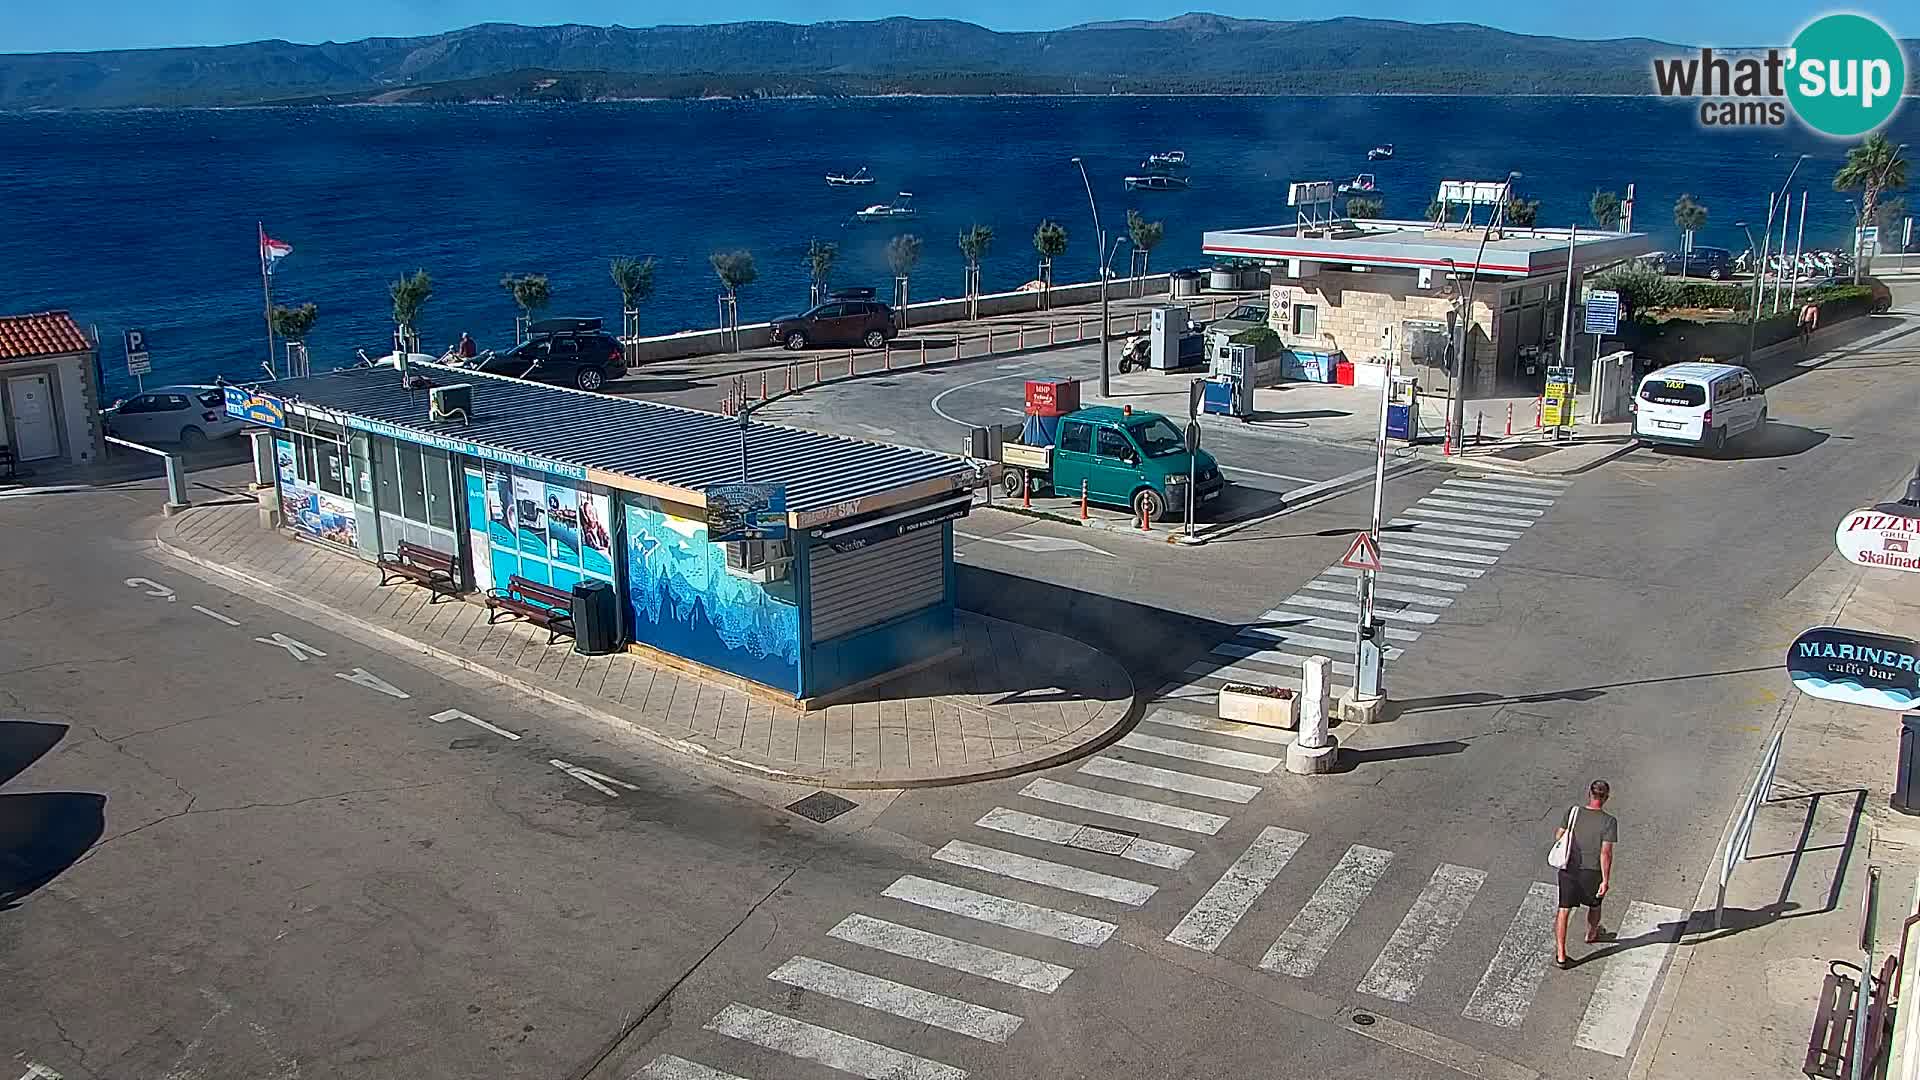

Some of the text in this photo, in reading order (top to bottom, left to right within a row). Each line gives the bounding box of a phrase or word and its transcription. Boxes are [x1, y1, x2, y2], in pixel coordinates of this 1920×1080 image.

[1666, 381, 1684, 389] TAXI
[396, 426, 435, 445] AUTOBUSNA
[436, 437, 466, 452] POSTAJA
[478, 447, 582, 477] BUS STATION TICKET OFFICE
[1881, 531, 1913, 541] GRILL
[1828, 662, 1896, 681] caffe bar
